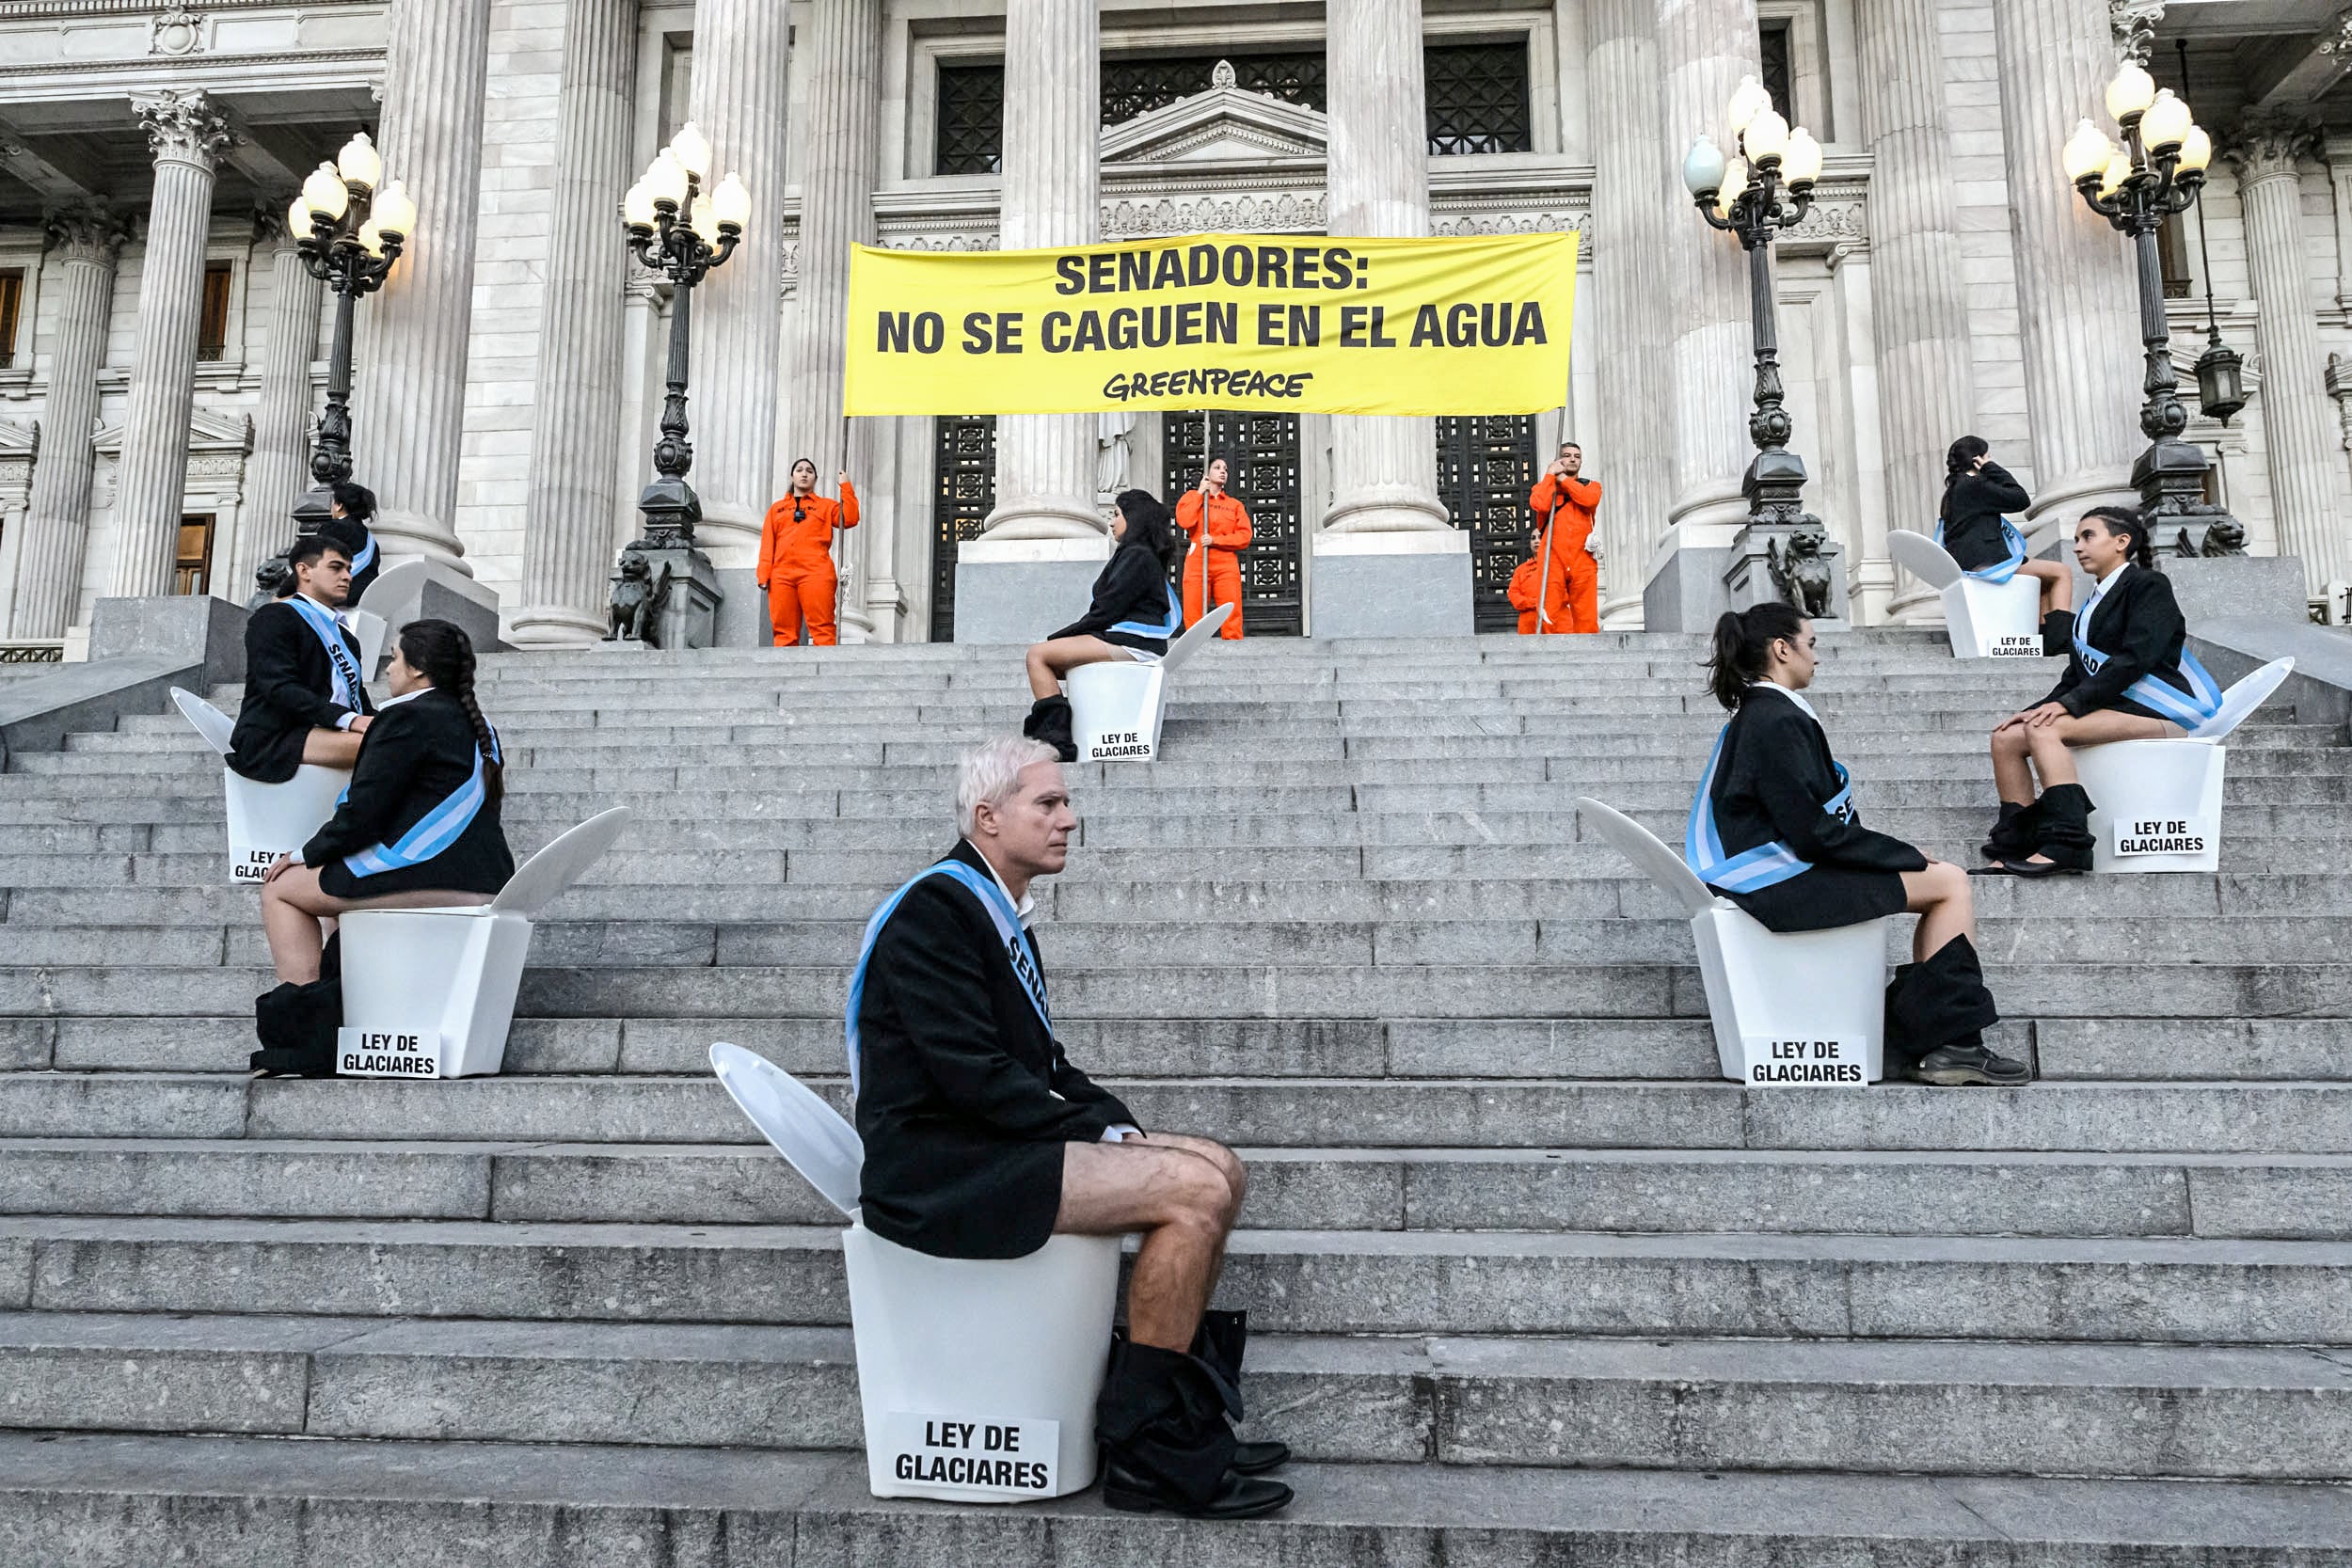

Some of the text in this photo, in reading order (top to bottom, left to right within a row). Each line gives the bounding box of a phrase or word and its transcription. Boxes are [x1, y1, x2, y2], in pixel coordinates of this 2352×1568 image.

[1055, 244, 1369, 295] SENADORES:
[877, 301, 1549, 355] NO SE CAGUEN EN EL AGUA
[1102, 368, 1314, 402] GREENPEACE
[2001, 637, 2031, 645] LEY DE
[1992, 647, 2041, 656] GLACIARES
[1102, 733, 1138, 744] LEY DE
[1091, 744, 1150, 758] GLACIARES
[2135, 820, 2186, 835] LEY DE
[2120, 837, 2204, 852] GLACIARES
[250, 850, 276, 864] LEY
[361, 1033, 419, 1052] LEY DE
[1772, 1041, 1839, 1059] LEY DE
[343, 1053, 435, 1074] GLACIARES
[1752, 1064, 1862, 1082] GLACIARES
[925, 1420, 1021, 1452] LEY DE
[896, 1453, 1049, 1490] GLACIARES
